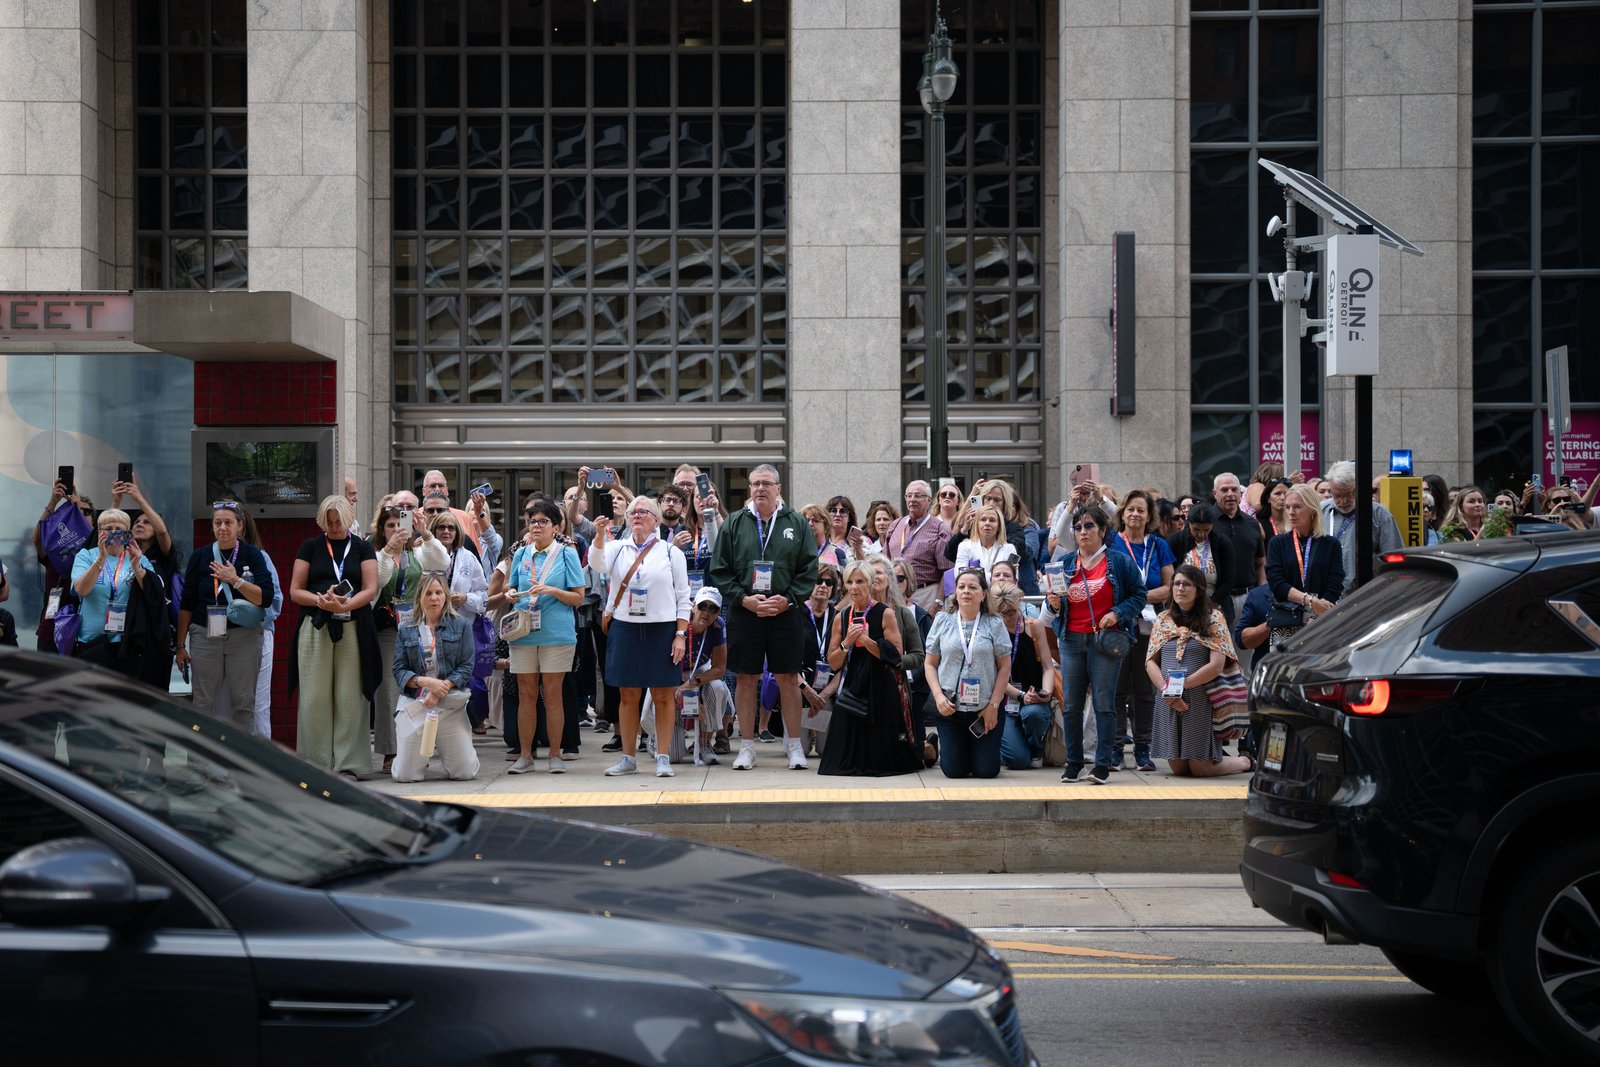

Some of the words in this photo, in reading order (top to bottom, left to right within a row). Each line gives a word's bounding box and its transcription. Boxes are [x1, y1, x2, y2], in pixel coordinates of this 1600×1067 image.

[1349, 268, 1374, 341] QLINE
[0, 301, 105, 330] EET
[1262, 442, 1315, 451] CATNG
[1545, 441, 1600, 450] CTERING
[1262, 452, 1315, 461] AVAILE
[1408, 486, 1420, 547] EMER
